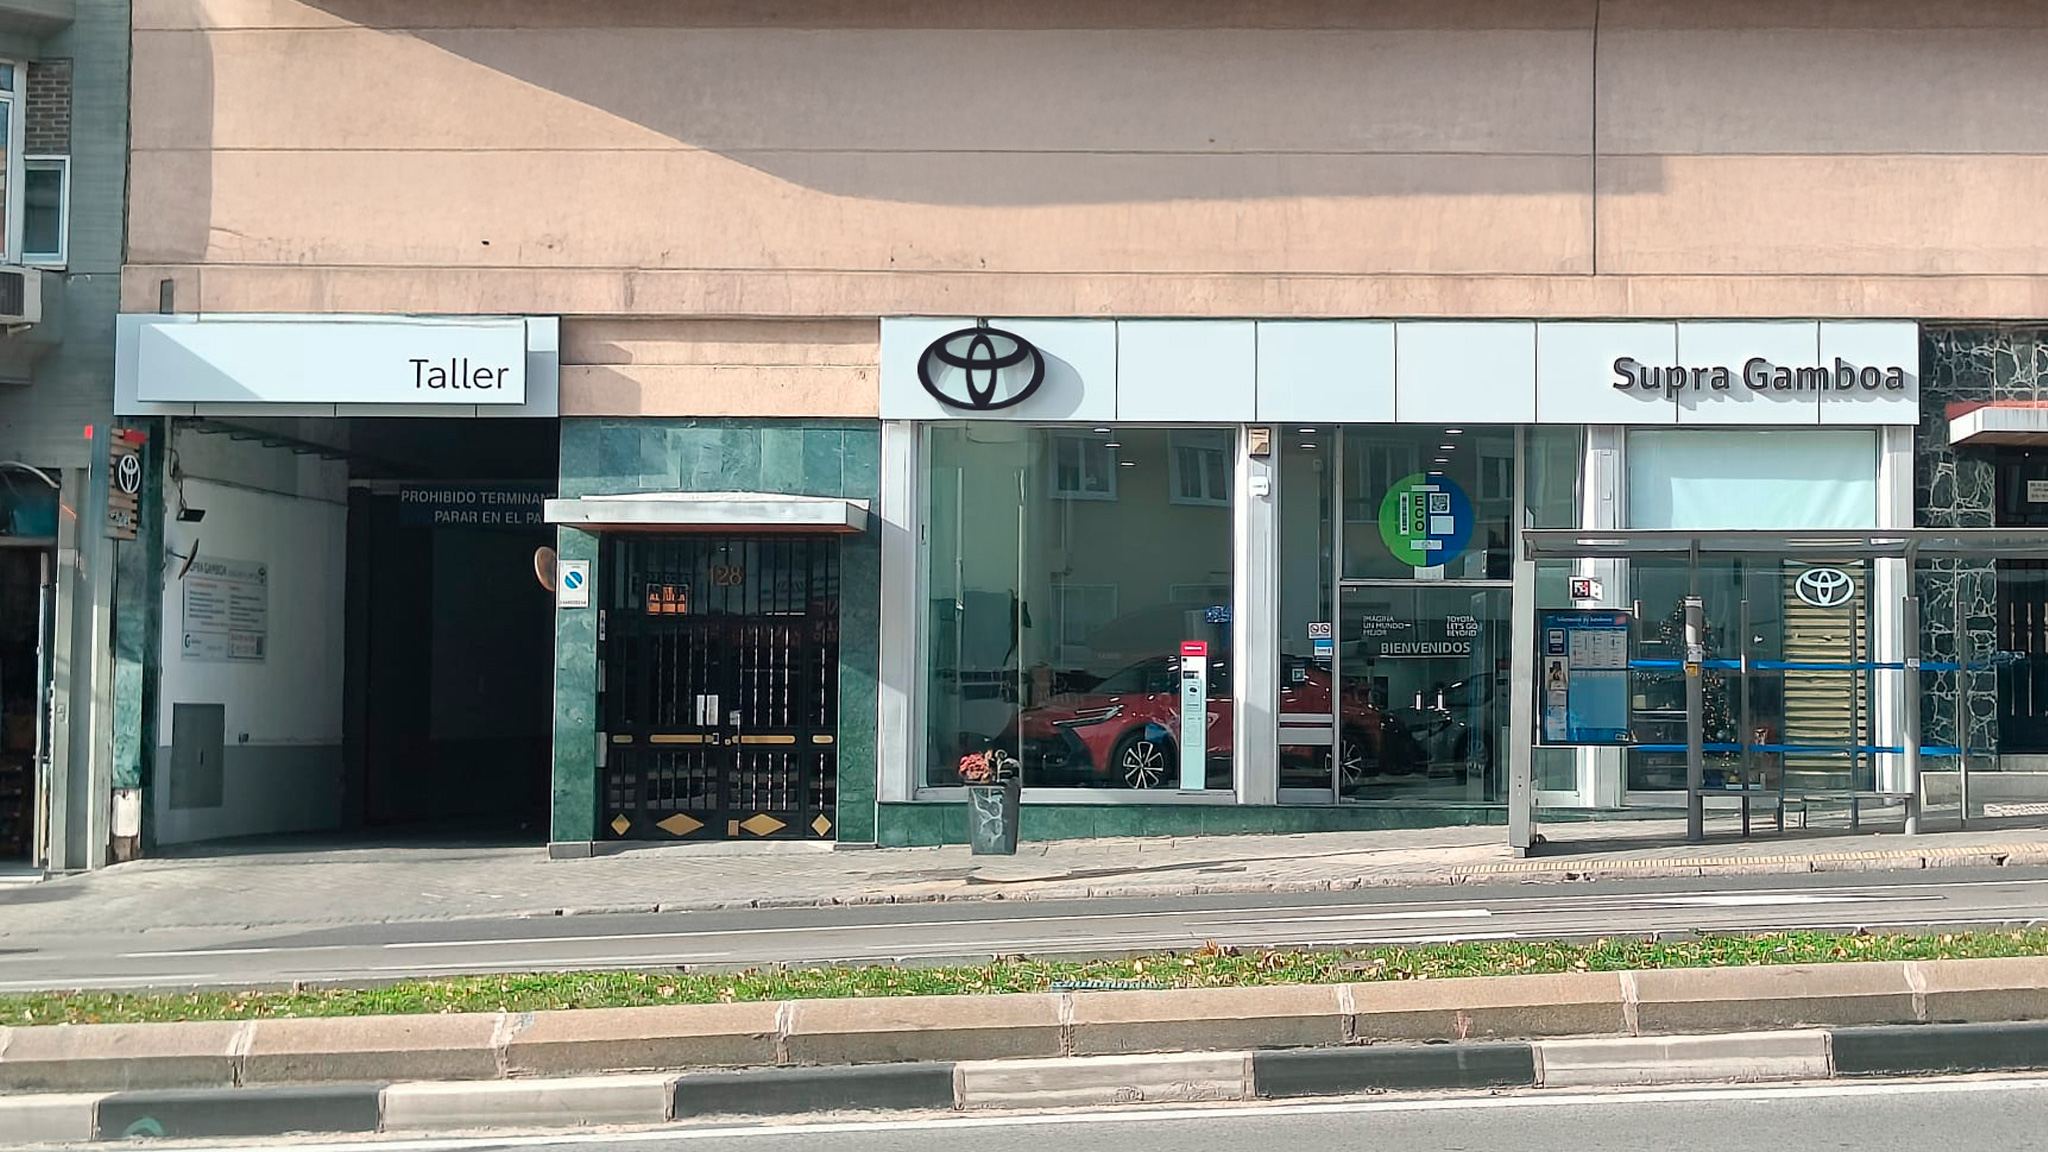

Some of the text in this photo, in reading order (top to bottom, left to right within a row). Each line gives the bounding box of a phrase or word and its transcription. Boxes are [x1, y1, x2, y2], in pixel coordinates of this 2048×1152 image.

[408, 357, 510, 390] Taller
[1612, 356, 1906, 399] Supra Gamboa
[400, 489, 477, 504] PROHIBIDO
[433, 510, 478, 524] PARAR
[482, 511, 501, 524] EN
[504, 511, 522, 524] EL
[1414, 495, 1425, 532] ECO
[710, 563, 743, 587] 128
[1380, 641, 1471, 654] BIENVENIDOS
